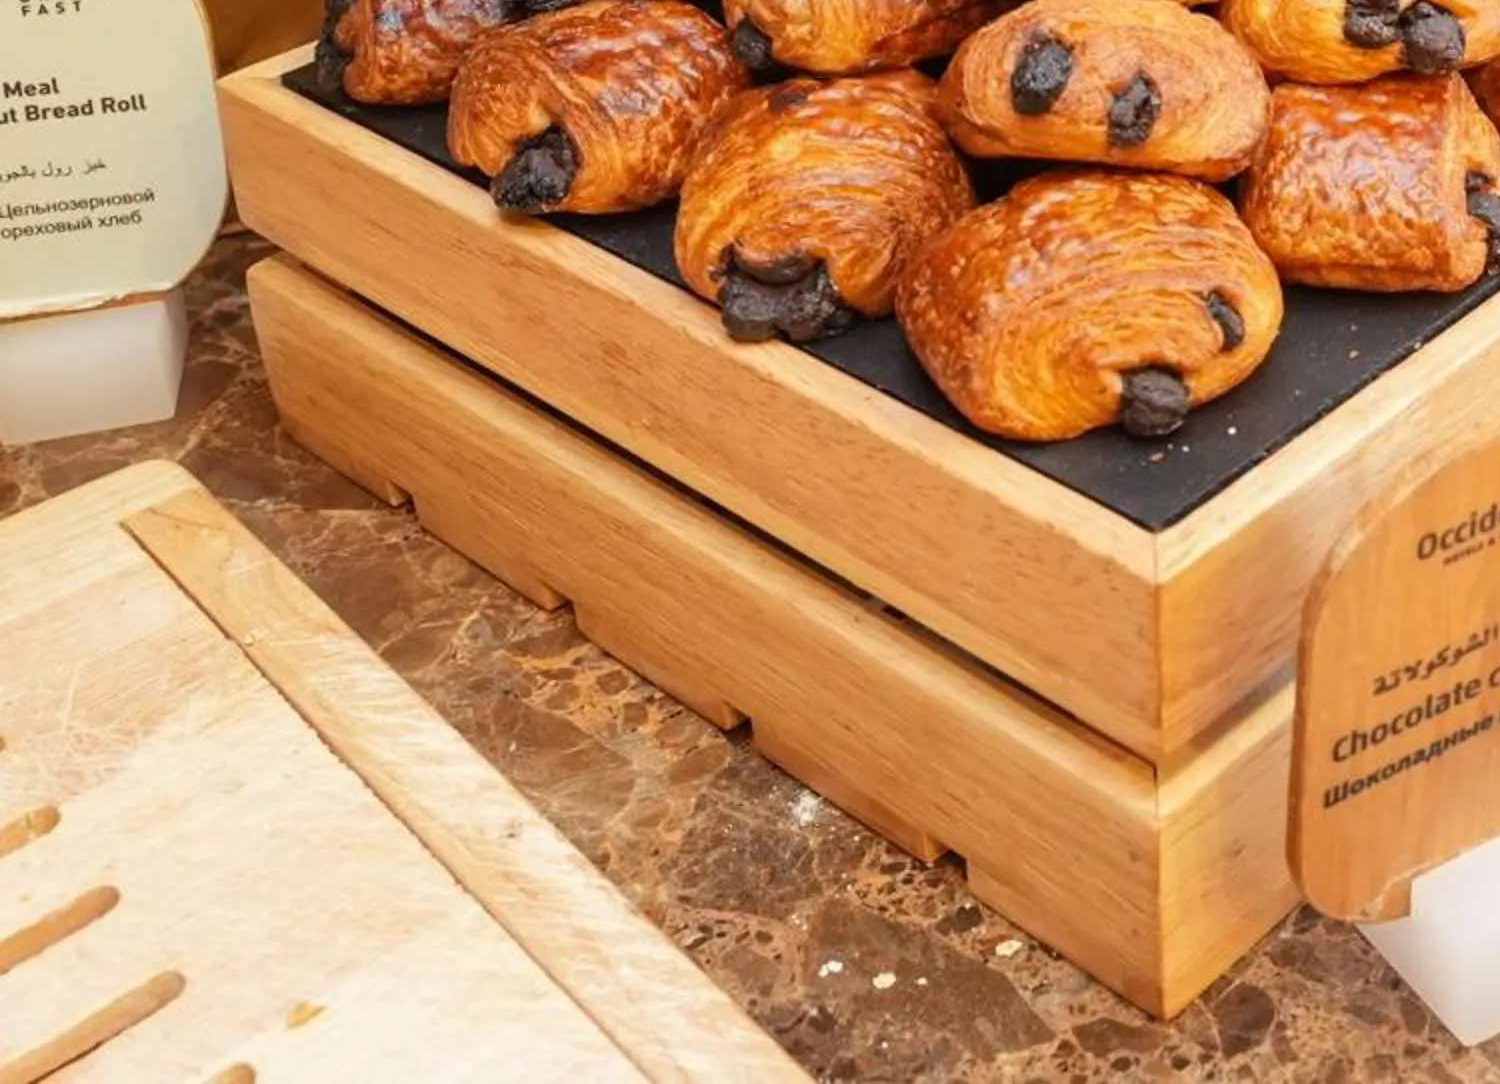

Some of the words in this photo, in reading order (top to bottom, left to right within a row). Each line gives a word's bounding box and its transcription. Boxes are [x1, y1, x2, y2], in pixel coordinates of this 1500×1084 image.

[20, 0, 82, 17] FAST
[2, 77, 60, 99] Meal
[25, 99, 94, 122] Bread
[101, 93, 147, 115] Roll
[97, 209, 143, 227] хлеб
[1331, 677, 1482, 764] Chocolate
[1322, 715, 1494, 810] Шоколадные
